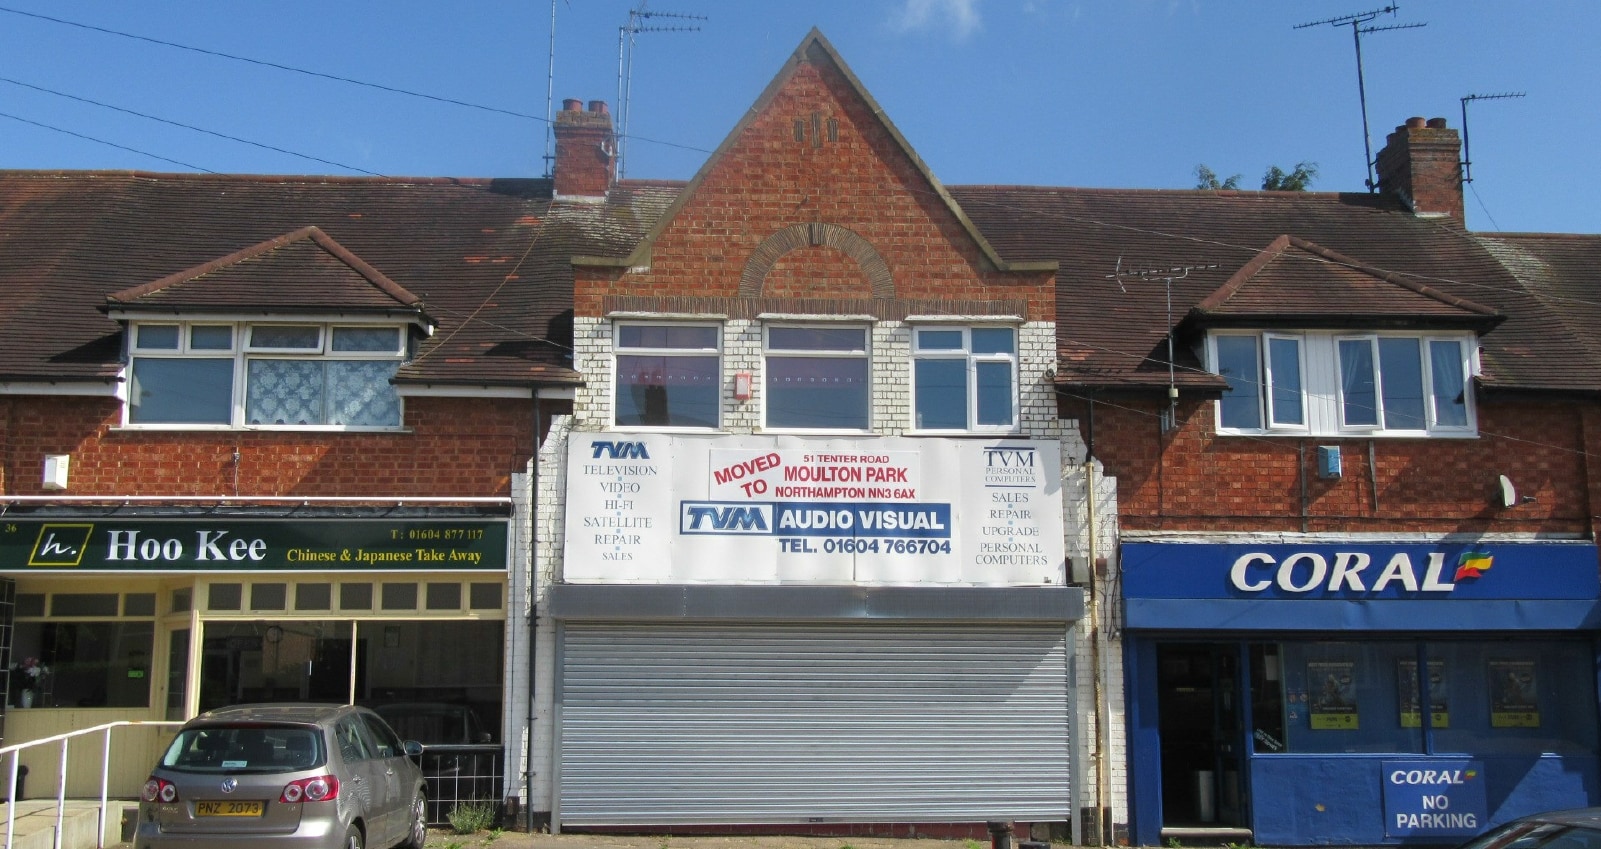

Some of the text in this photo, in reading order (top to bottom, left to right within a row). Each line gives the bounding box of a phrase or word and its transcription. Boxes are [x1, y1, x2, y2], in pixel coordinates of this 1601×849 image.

[591, 441, 650, 459] TVM
[803, 454, 890, 464] 51 TENTER ROAD
[983, 450, 1034, 467] TVM
[583, 465, 657, 476] TELEVISION
[713, 452, 781, 485] MOVED
[784, 465, 908, 483] MOULTON PARK
[985, 467, 1035, 475] PERSONAL
[985, 475, 1036, 483] COMPUTERS
[600, 482, 640, 493] VIDEO
[740, 479, 768, 498] TO
[775, 486, 915, 499] NORTHAMPTON NN3 6AX
[992, 492, 1029, 503] SALES
[605, 500, 633, 510] HI-FI
[687, 505, 769, 531] TVM
[779, 509, 945, 530] AUDIO VISUAL
[990, 509, 1032, 519] REPAIR
[5, 523, 17, 533] 36
[584, 517, 652, 528] SATELLITE
[409, 529, 440, 540] 01604
[444, 529, 464, 540] 877
[467, 529, 484, 540] 117
[982, 526, 1039, 536] UPGRADE
[594, 534, 641, 545] REPAIR
[105, 530, 267, 561] Hoo Kee
[779, 538, 951, 554] TEL. 01604 766704
[980, 543, 1043, 553] PERSONAL
[286, 548, 482, 565] Chinese & Japanese Take Away
[602, 552, 633, 561] SALES
[975, 555, 1048, 566] COMPUTERS
[1230, 552, 1455, 592] CORAL
[1390, 770, 1464, 785] CORAL
[198, 802, 259, 814] PNZ 2073
[1422, 795, 1449, 810] NO
[1396, 813, 1477, 829] PARKING
